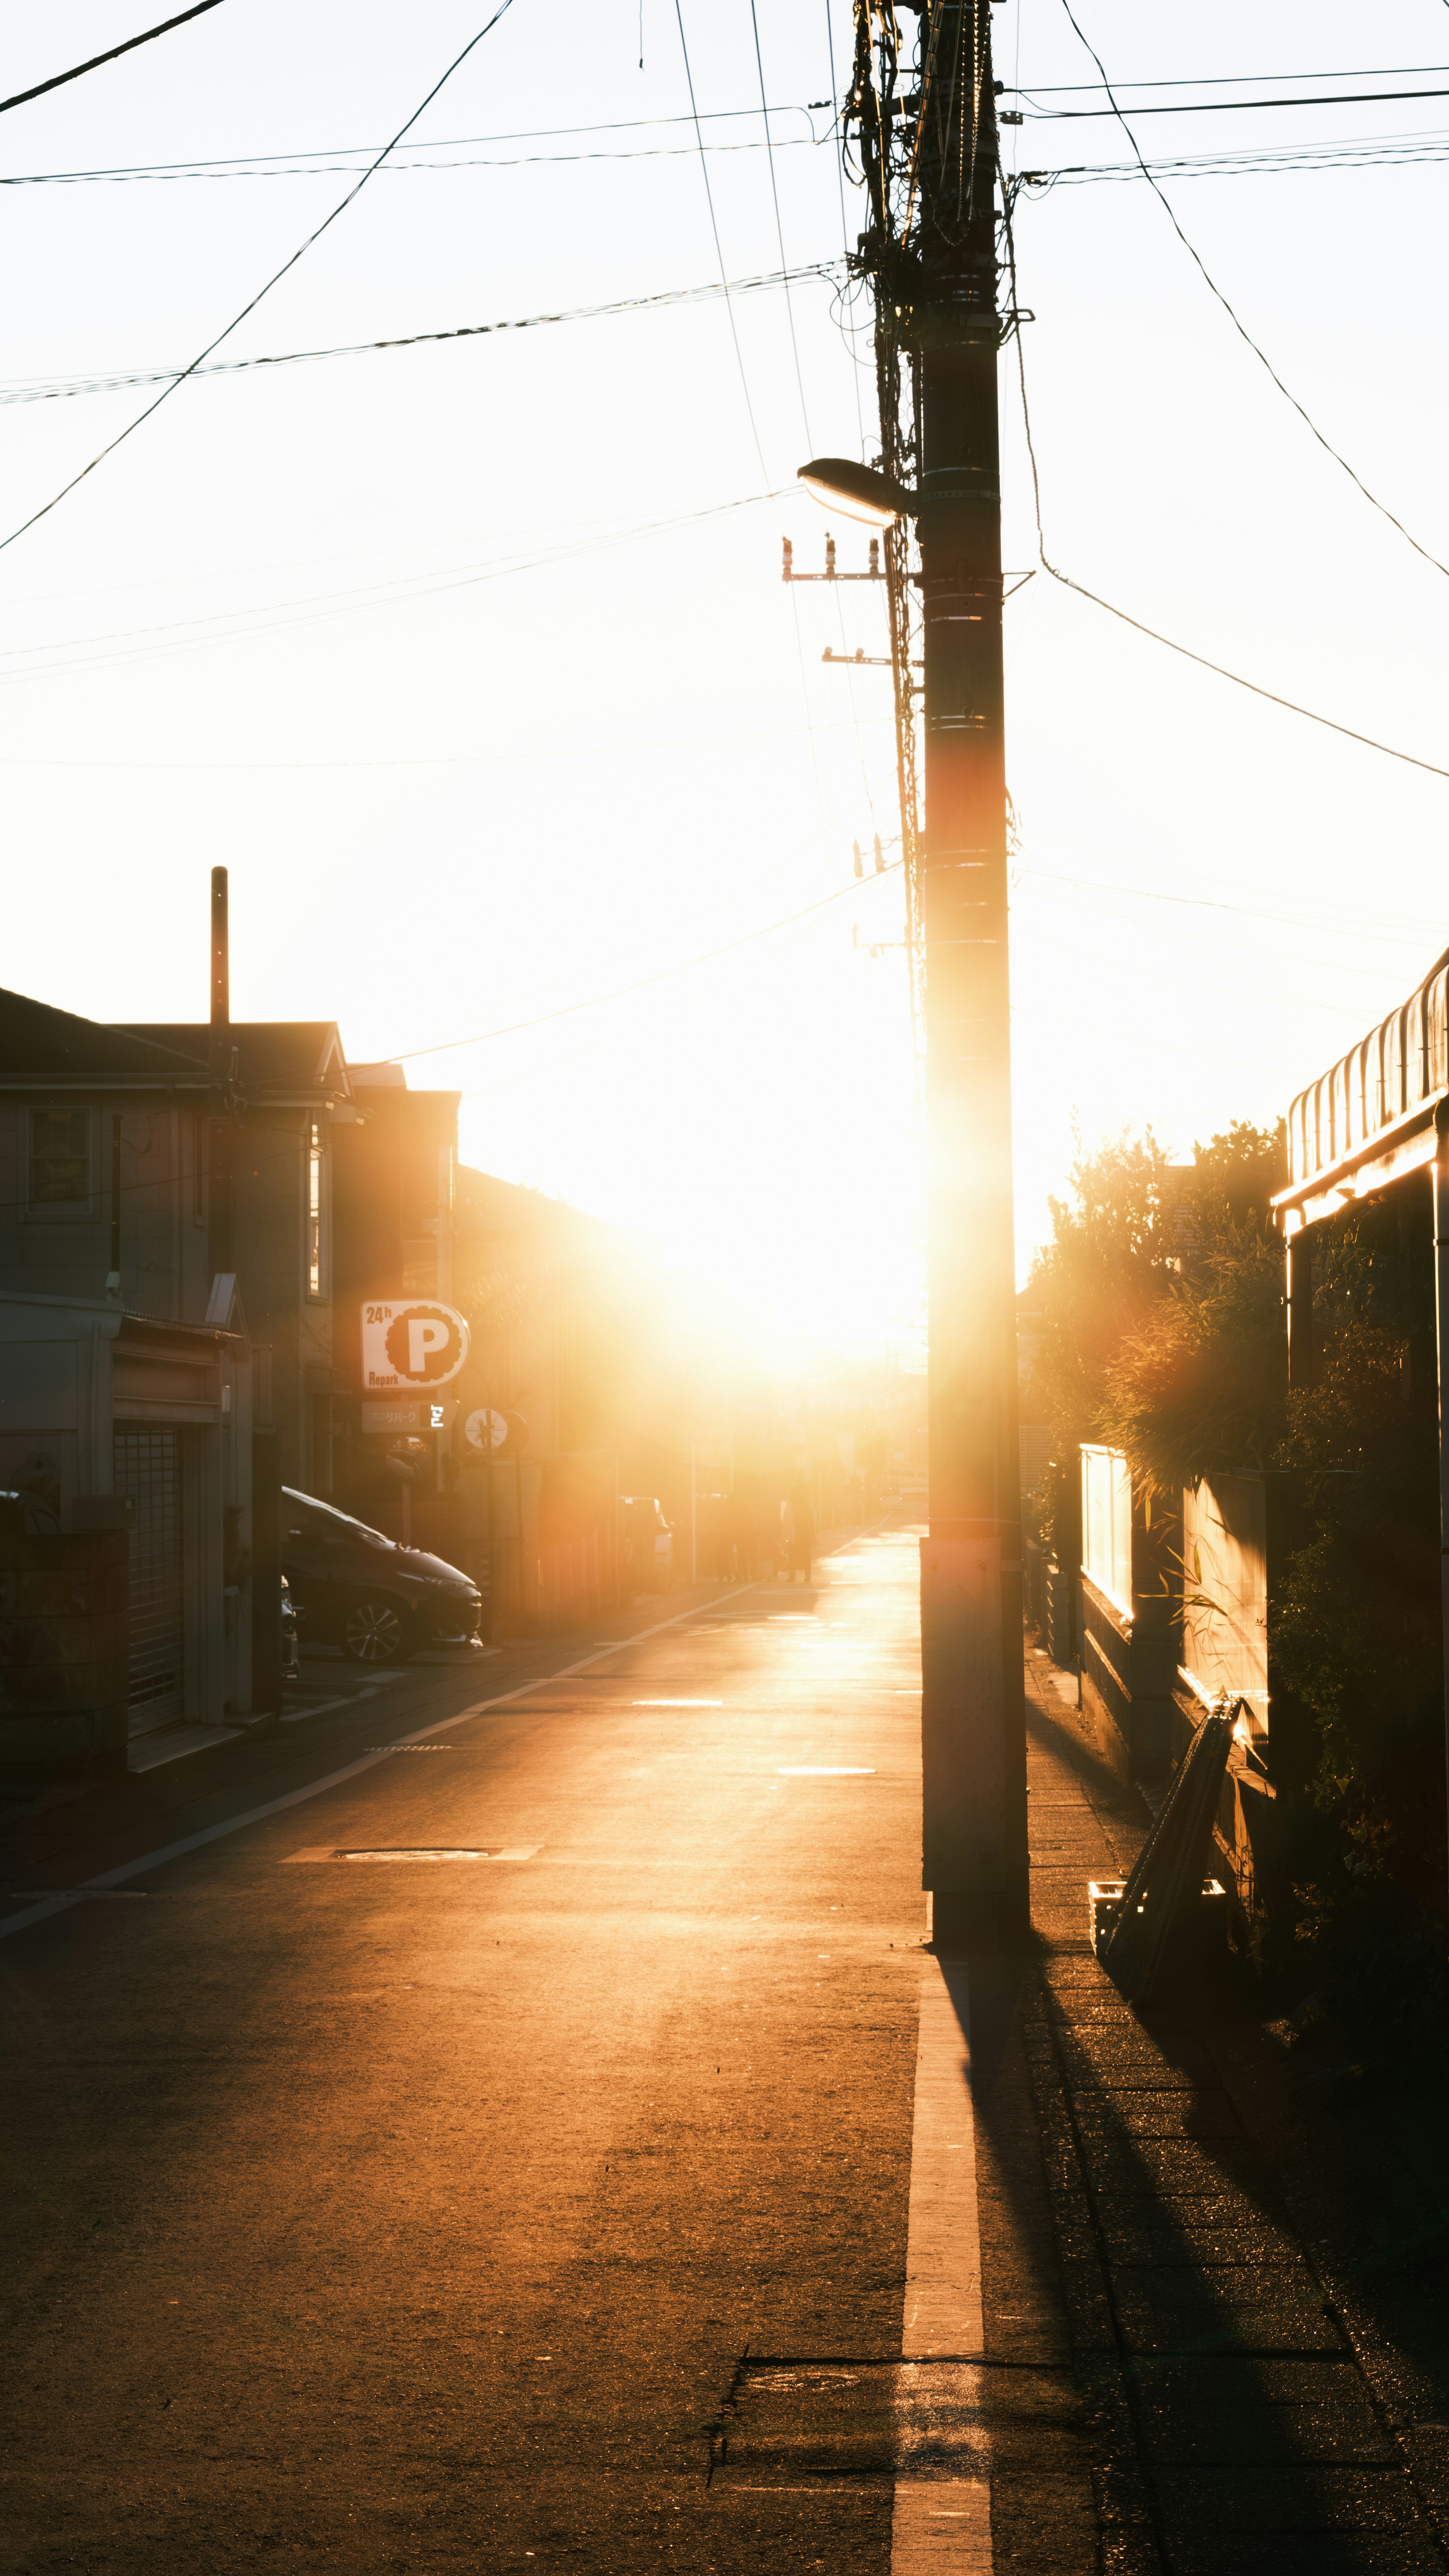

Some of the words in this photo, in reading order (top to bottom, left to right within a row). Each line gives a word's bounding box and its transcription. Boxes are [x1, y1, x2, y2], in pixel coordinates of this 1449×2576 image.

[366, 1306, 392, 1324] 24h
[408, 1319, 449, 1372] P
[369, 1371, 399, 1387] Repark
